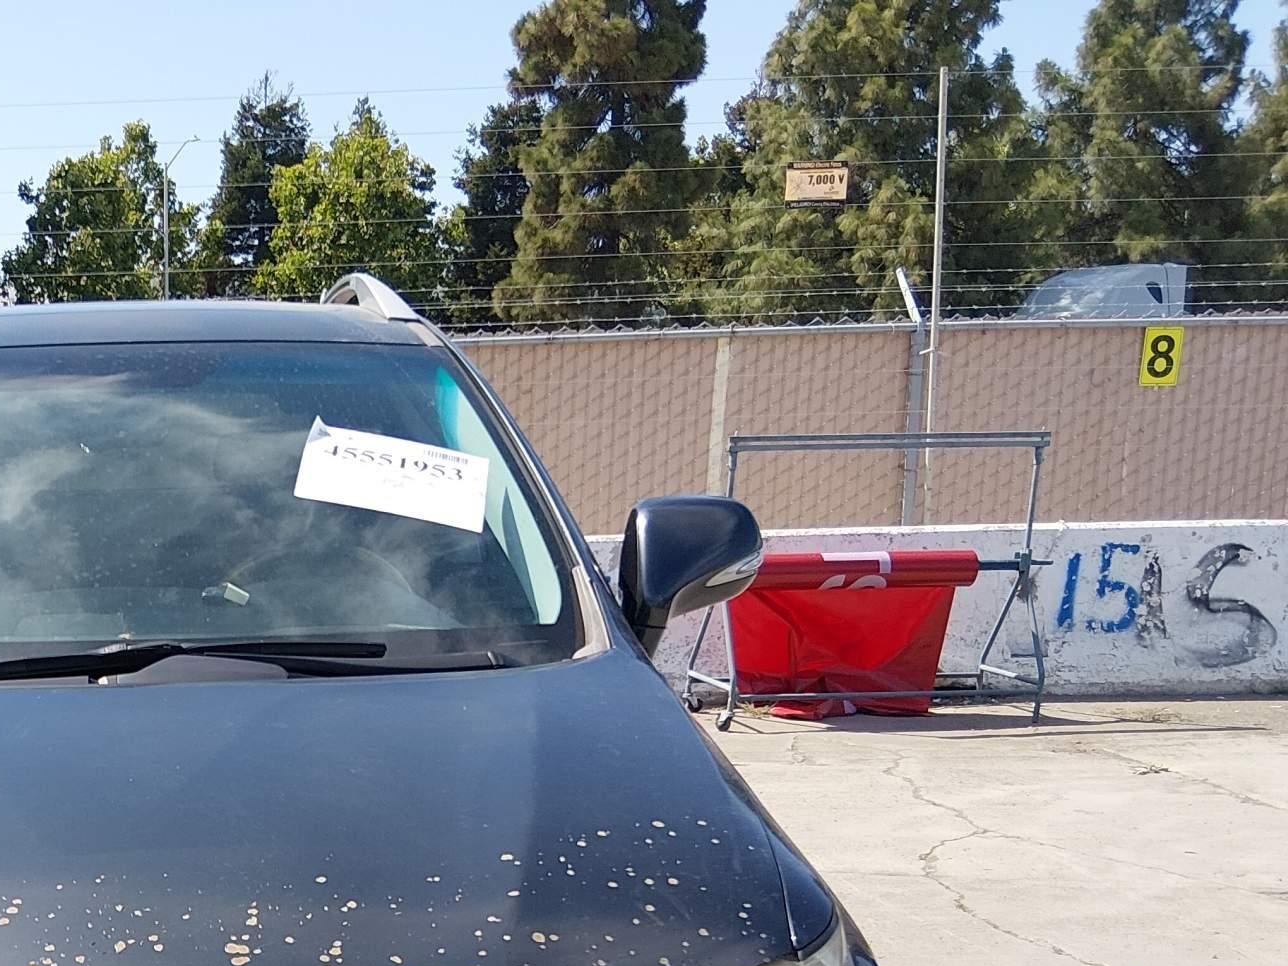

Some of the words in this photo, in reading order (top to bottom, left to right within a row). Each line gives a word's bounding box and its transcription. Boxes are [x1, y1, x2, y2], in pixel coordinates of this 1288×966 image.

[808, 174, 835, 186] 7,000
[838, 174, 845, 185] V
[1147, 335, 1175, 378] 8
[324, 445, 463, 480] 45551953
